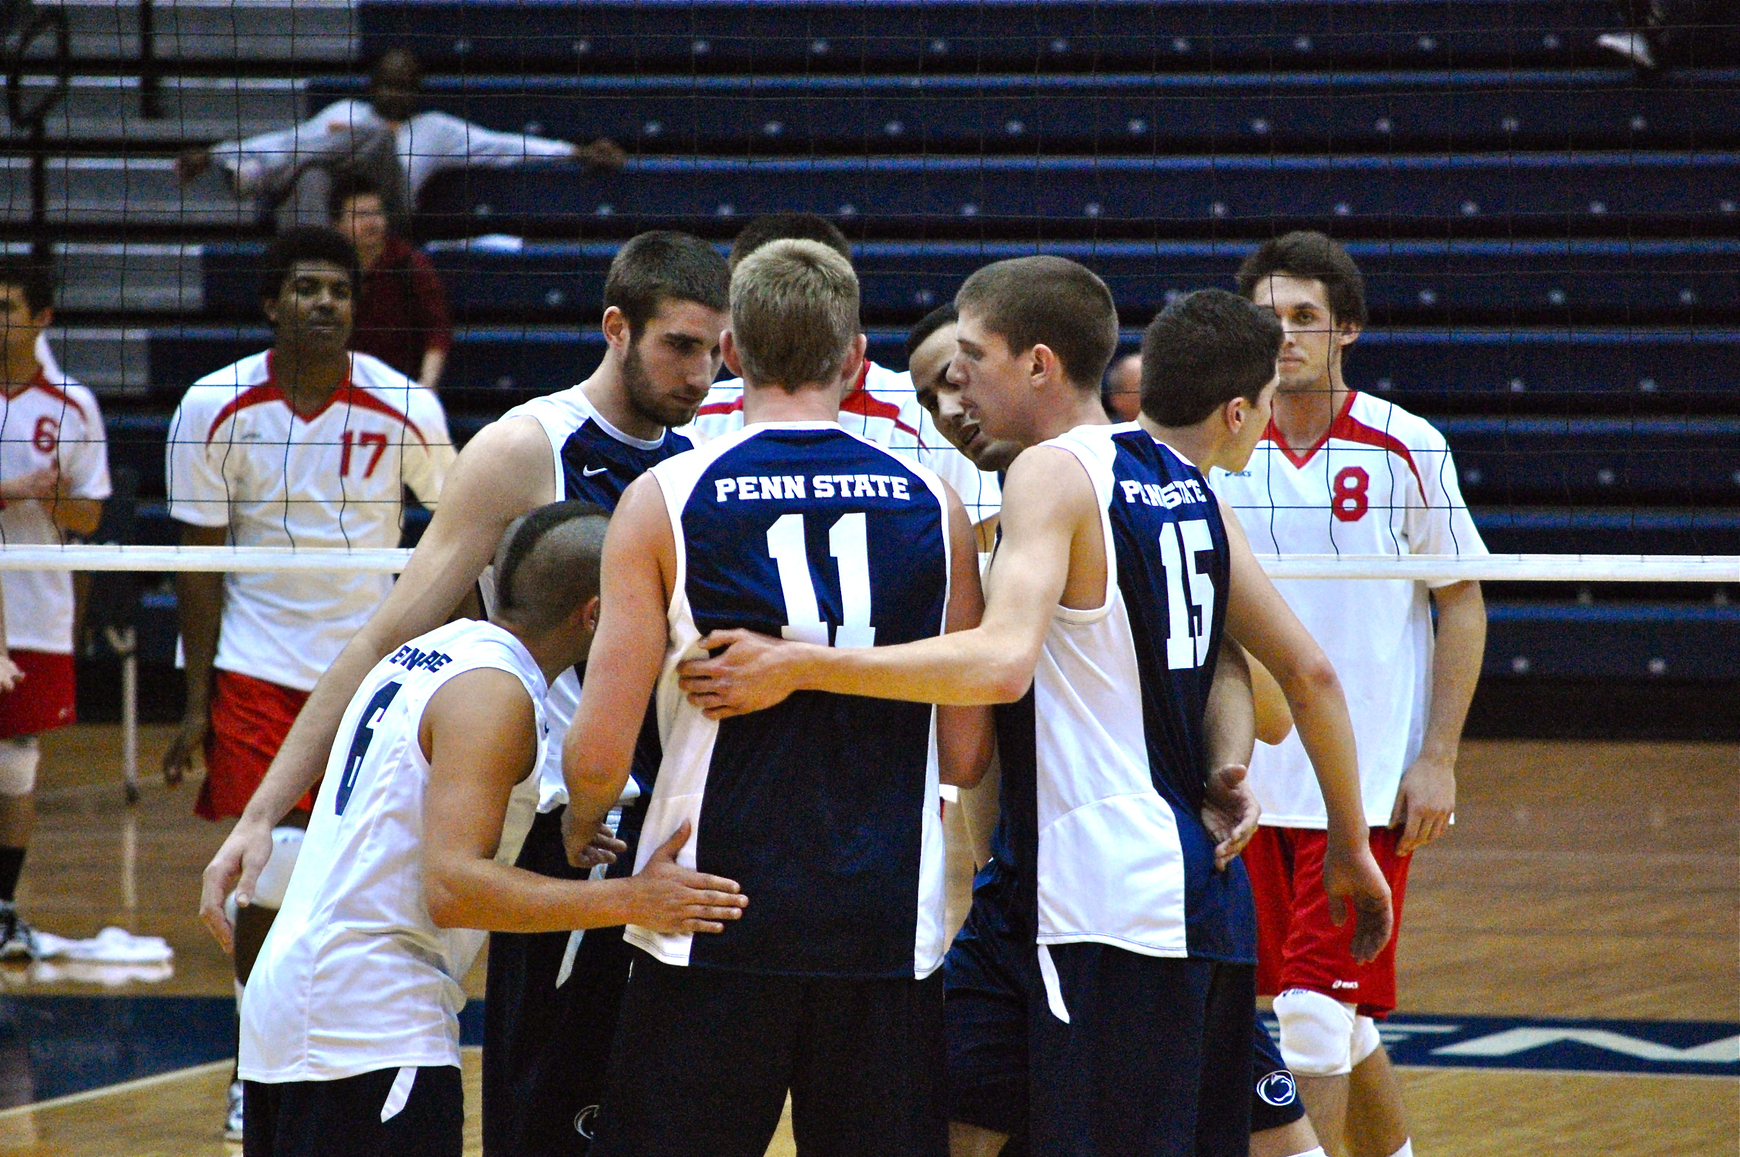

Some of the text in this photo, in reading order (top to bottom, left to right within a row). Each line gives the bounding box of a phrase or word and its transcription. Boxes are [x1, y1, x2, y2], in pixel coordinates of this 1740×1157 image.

[33, 415, 57, 453] 6
[340, 429, 388, 479] 17
[714, 474, 911, 503] PENN STATE
[1332, 466, 1370, 523] 8
[766, 512, 877, 648] 11
[1158, 519, 1216, 670] 15
[334, 680, 403, 816] 6
